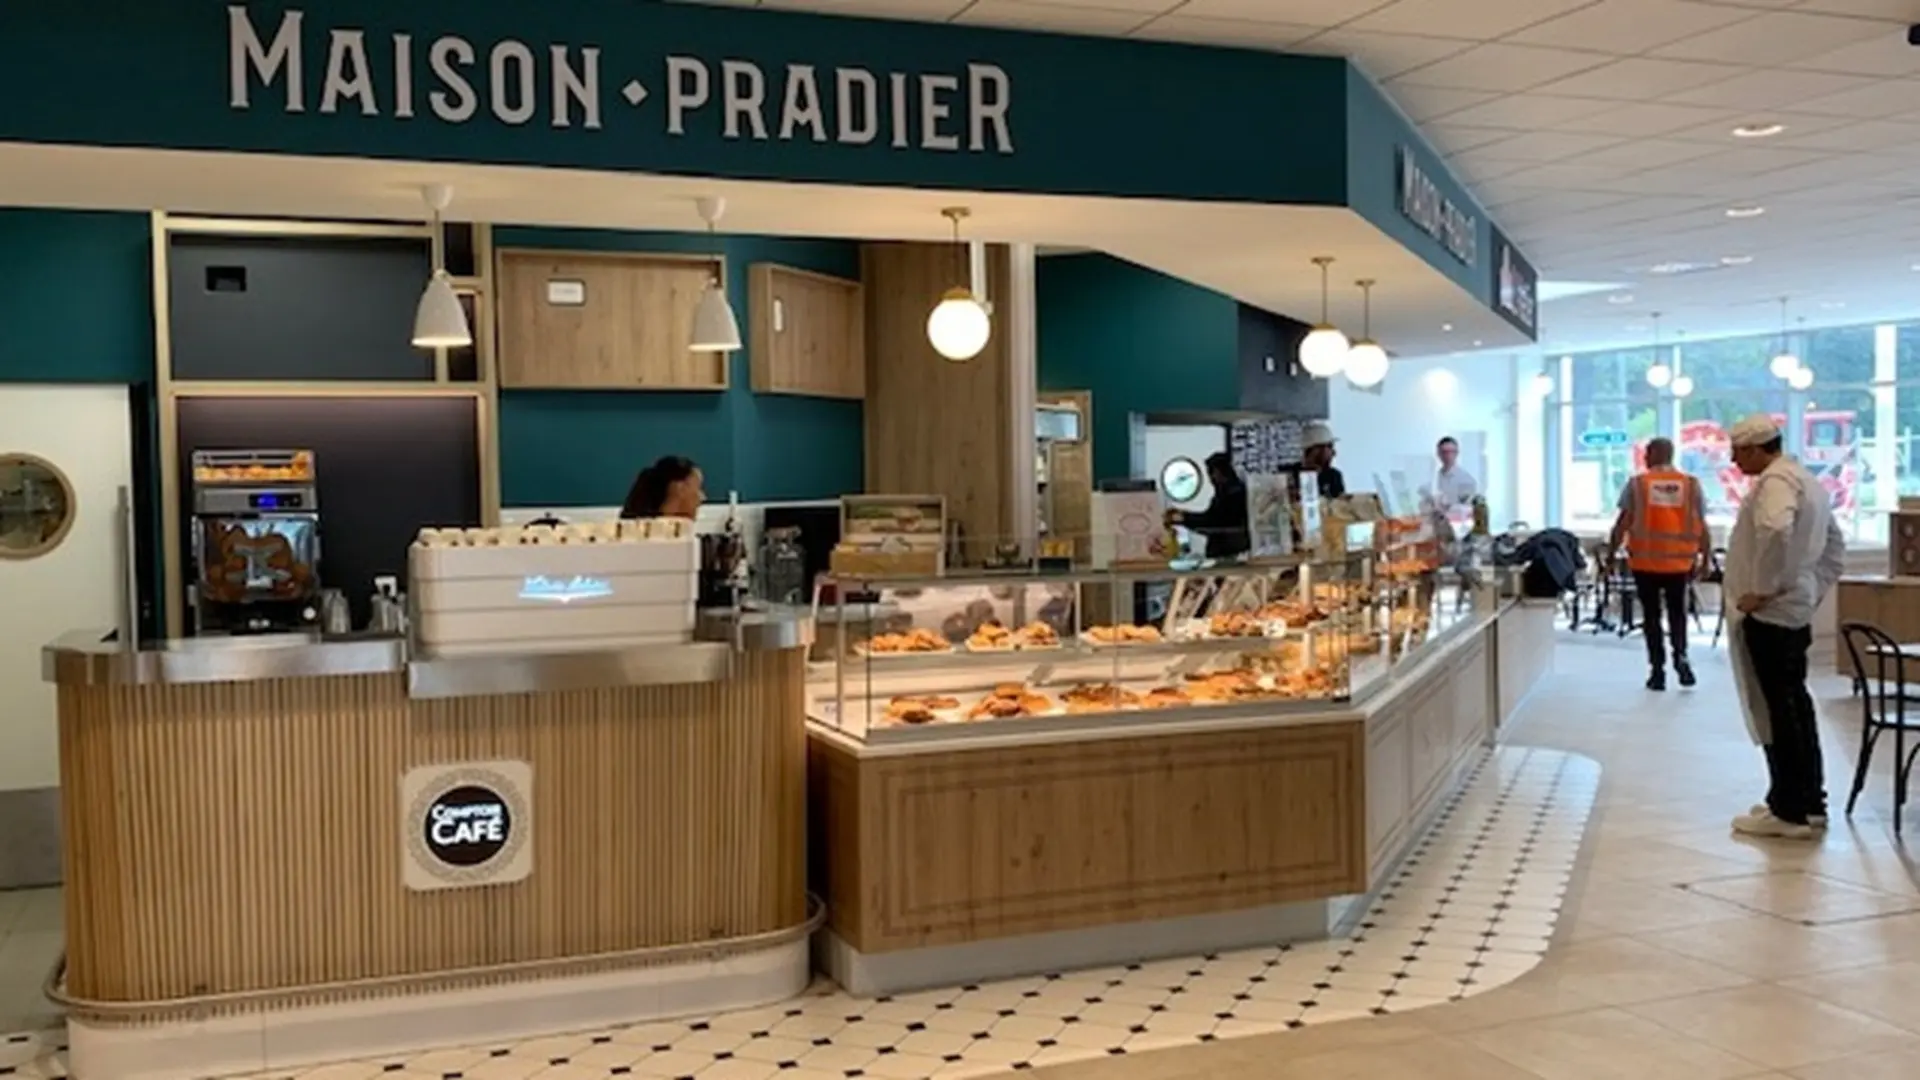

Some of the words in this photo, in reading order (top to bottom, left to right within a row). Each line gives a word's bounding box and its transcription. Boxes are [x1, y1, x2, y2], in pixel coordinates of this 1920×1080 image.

[228, 5, 602, 129] MAISON
[665, 54, 1014, 154] PRADIER
[430, 816, 504, 846] CAFÉ
